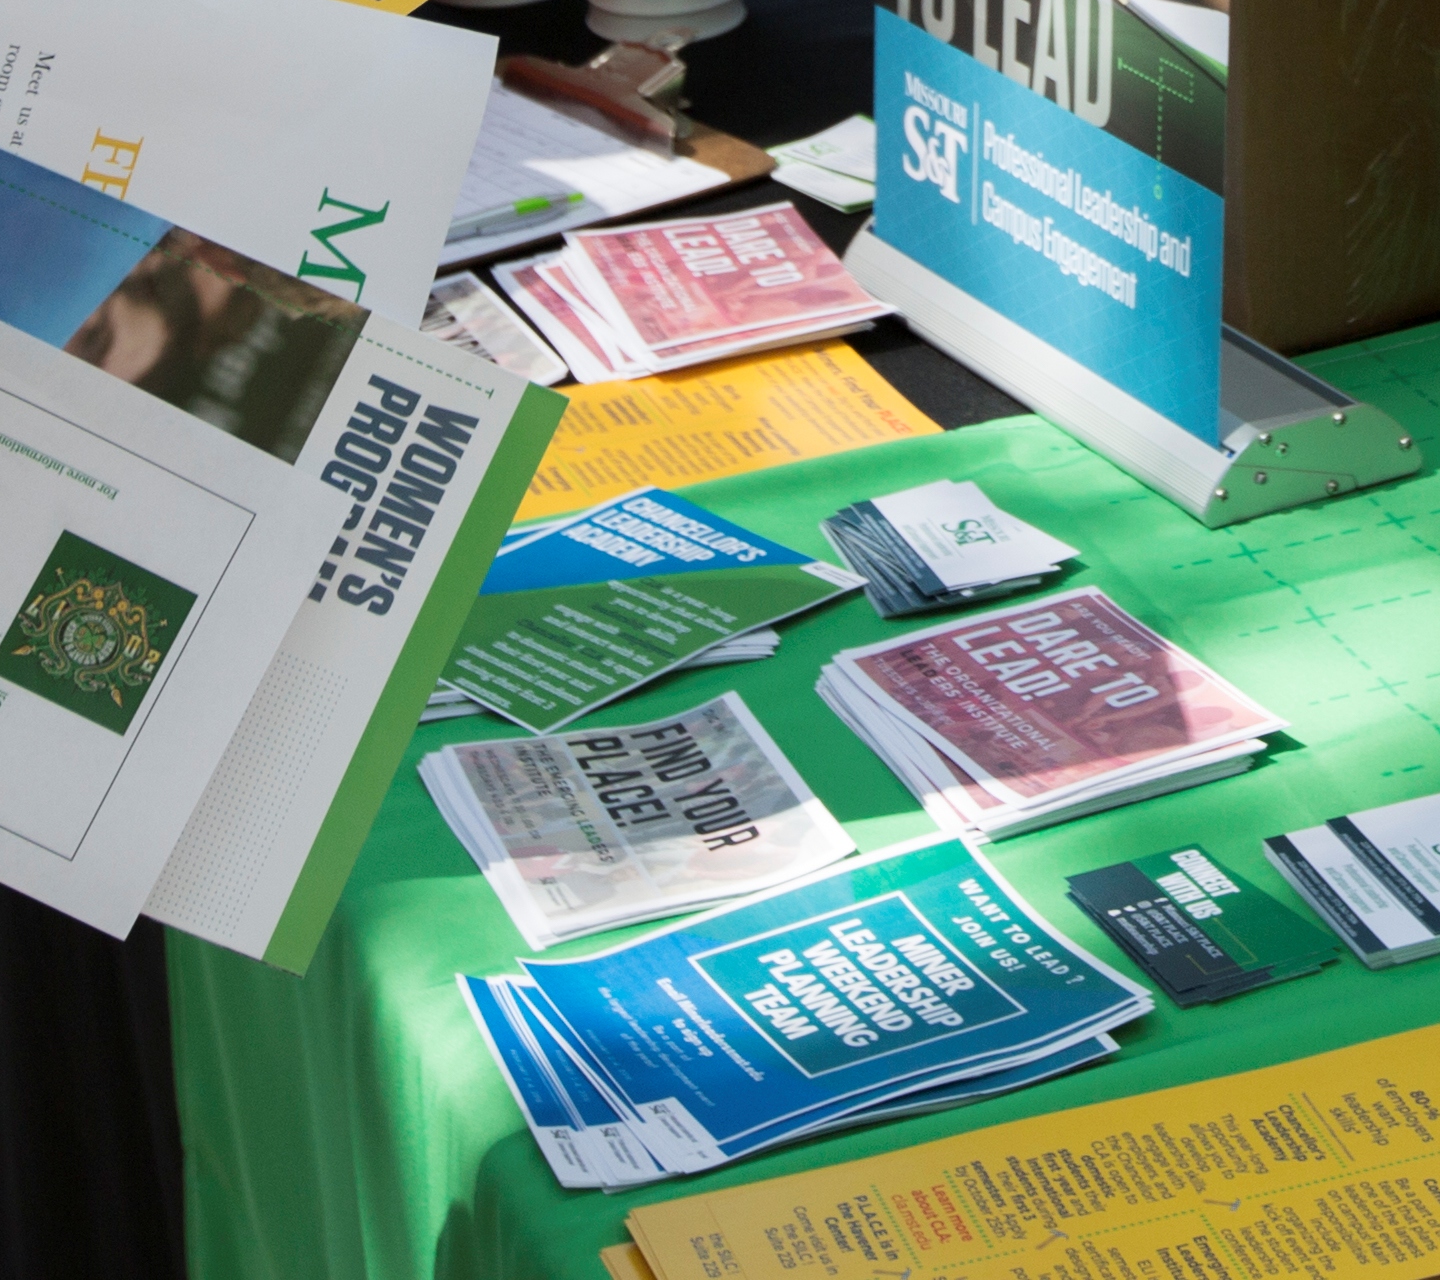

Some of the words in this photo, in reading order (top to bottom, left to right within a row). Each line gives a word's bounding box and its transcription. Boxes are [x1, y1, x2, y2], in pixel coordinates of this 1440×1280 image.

[25, 51, 55, 95] Meet
[904, 71, 967, 128] MISSOURI
[9, 130, 24, 146] at
[16, 106, 32, 125] us
[903, 105, 967, 204] S&T
[984, 121, 1073, 206] Professional
[1074, 175, 1158, 261] Leadership
[1160, 230, 1191, 278] and
[657, 223, 742, 279] LEAD!
[707, 217, 790, 265] DARE
[983, 185, 1042, 252] Campus
[1043, 221, 1137, 309] Engagement
[744, 260, 808, 289] TO
[337, 404, 479, 616] WOMEN'S
[594, 510, 717, 565] LEADERSHIP
[621, 496, 767, 563] CHANCELLOR'S
[560, 521, 666, 570] ACADEMY
[945, 625, 1078, 702] LEAD!
[1000, 610, 1125, 678] DARE
[1081, 670, 1164, 710] TO
[914, 642, 954, 666] THE
[941, 665, 1059, 751] ORGANIZATIONAL
[956, 699, 1028, 749] INSTITUTE
[512, 744, 553, 797] INSTITUTE
[531, 743, 556, 765] THE
[565, 732, 672, 831] PLACE!
[627, 721, 716, 784] FIND
[543, 764, 587, 818] EMERGING
[667, 777, 764, 853] YOUR
[1151, 871, 1211, 904] WITH
[1181, 898, 1226, 920] US
[1163, 848, 1248, 898] CONNECT
[946, 877, 1019, 924] WANT
[997, 922, 1037, 946] TO
[1022, 944, 1073, 977] LEAD
[946, 913, 1000, 948] JOIN
[985, 946, 1028, 973] US!
[790, 939, 924, 1036] WEEKEND
[817, 917, 976, 1032] LEADERSHIP
[884, 931, 983, 997] MINER
[736, 982, 823, 1041] TEAM
[747, 946, 889, 1051] PLANNING
